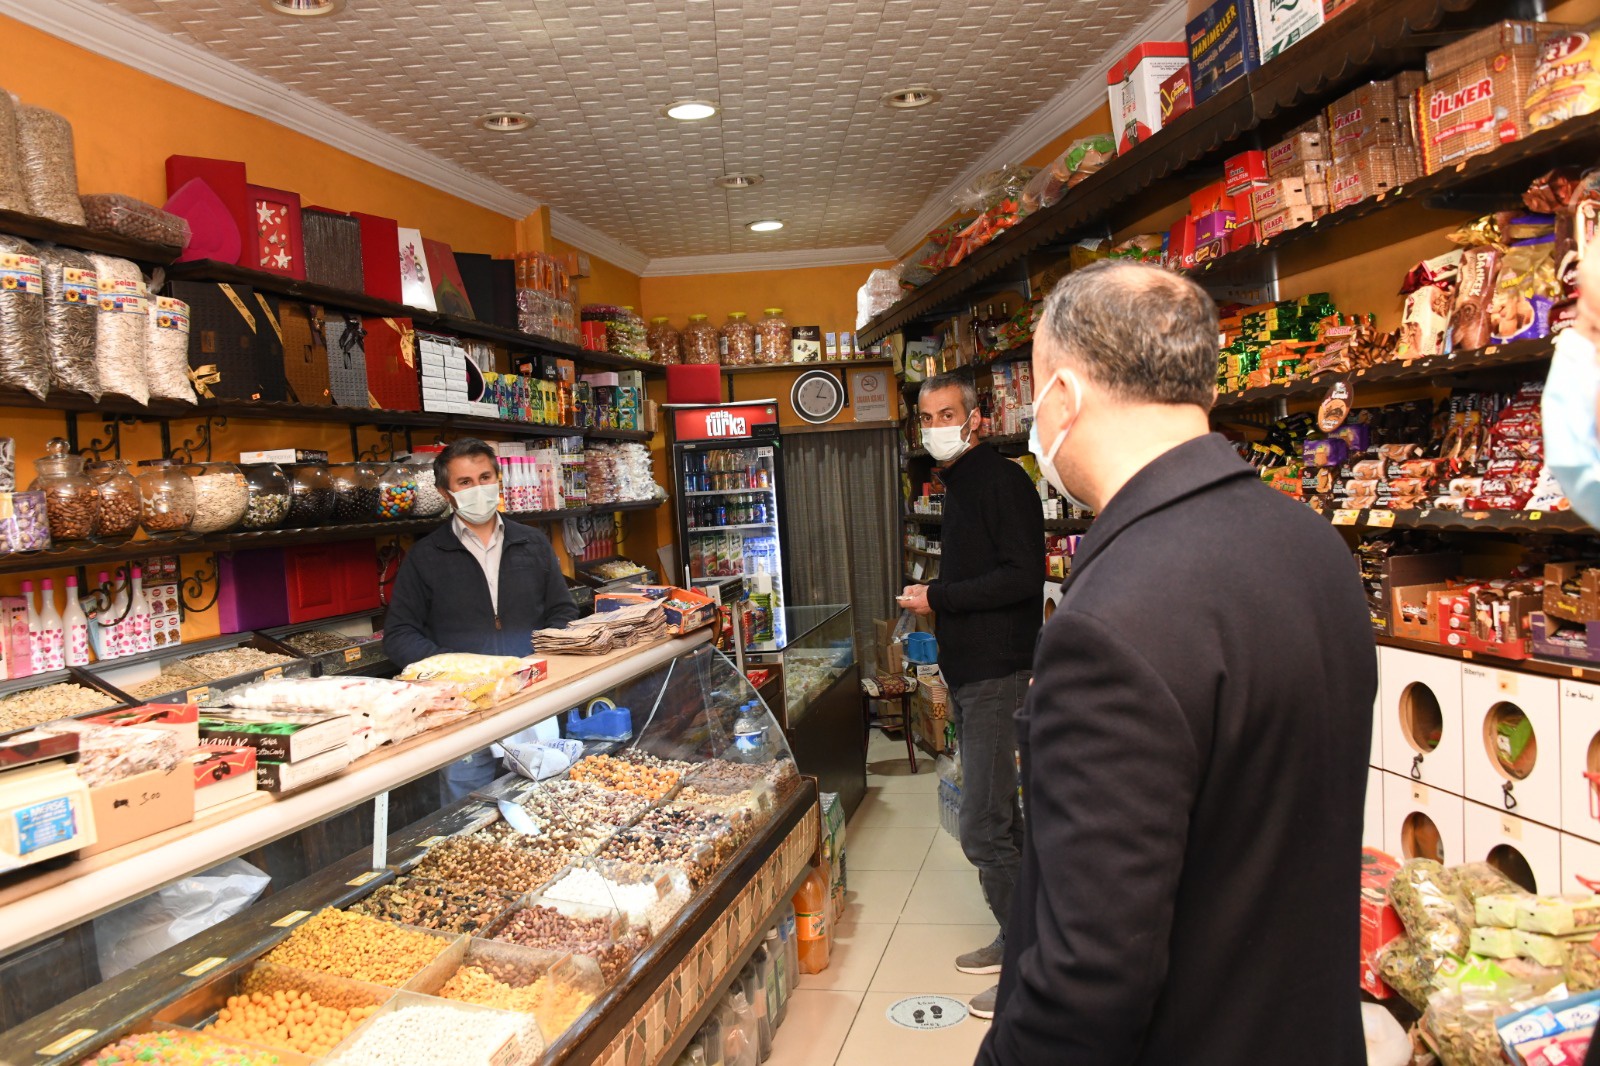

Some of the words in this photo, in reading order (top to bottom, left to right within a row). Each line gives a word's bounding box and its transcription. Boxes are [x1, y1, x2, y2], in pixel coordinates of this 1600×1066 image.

[1430, 78, 1492, 121] ÜLKER
[1334, 108, 1362, 130] ÜLKER
[1270, 142, 1292, 161] ÜLKER
[1255, 187, 1275, 205] ÜLKER
[1264, 215, 1283, 233] ÜLKER
[1468, 252, 1488, 297] DANKEK
[710, 410, 728, 419] cola
[705, 414, 745, 436] turka
